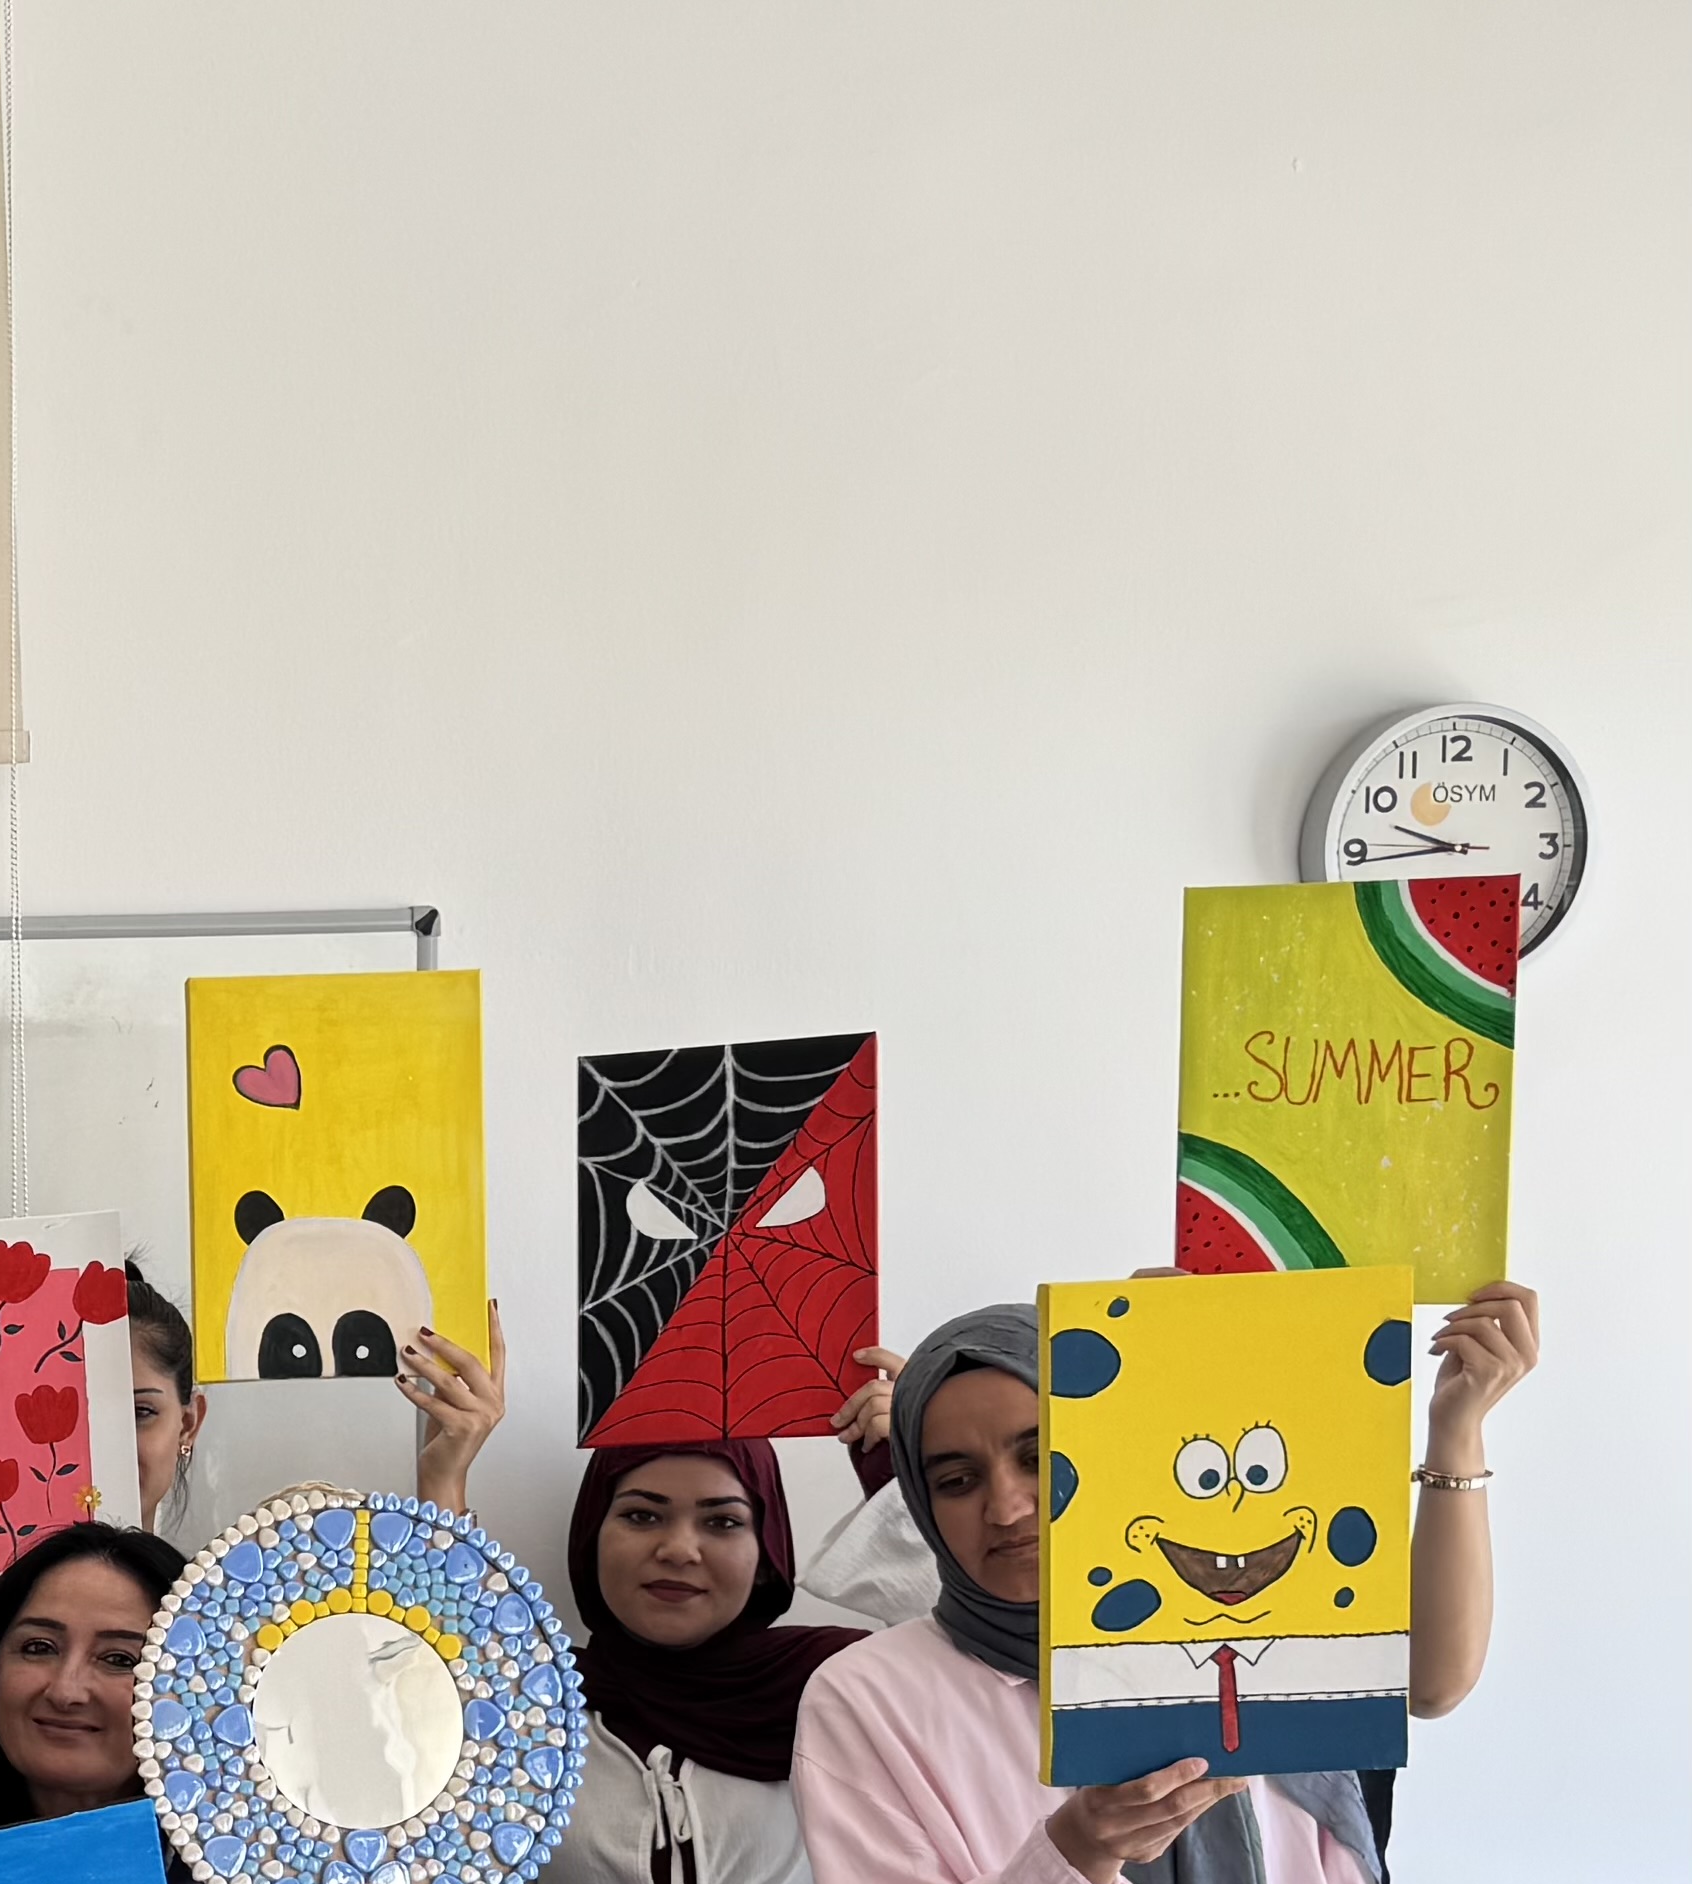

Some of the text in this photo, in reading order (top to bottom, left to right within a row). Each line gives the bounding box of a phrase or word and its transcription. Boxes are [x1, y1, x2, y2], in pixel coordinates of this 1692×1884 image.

[1441, 734, 1474, 763] 12
[1502, 747, 1509, 777] 1
[1398, 750, 1418, 779] 11
[1364, 785, 1398, 814] 10
[1432, 782, 1497, 804] ÖSYM
[1523, 781, 1547, 809] 2
[1343, 838, 1368, 867] 9
[1538, 832, 1560, 860] 3
[1520, 883, 1545, 911] 4
